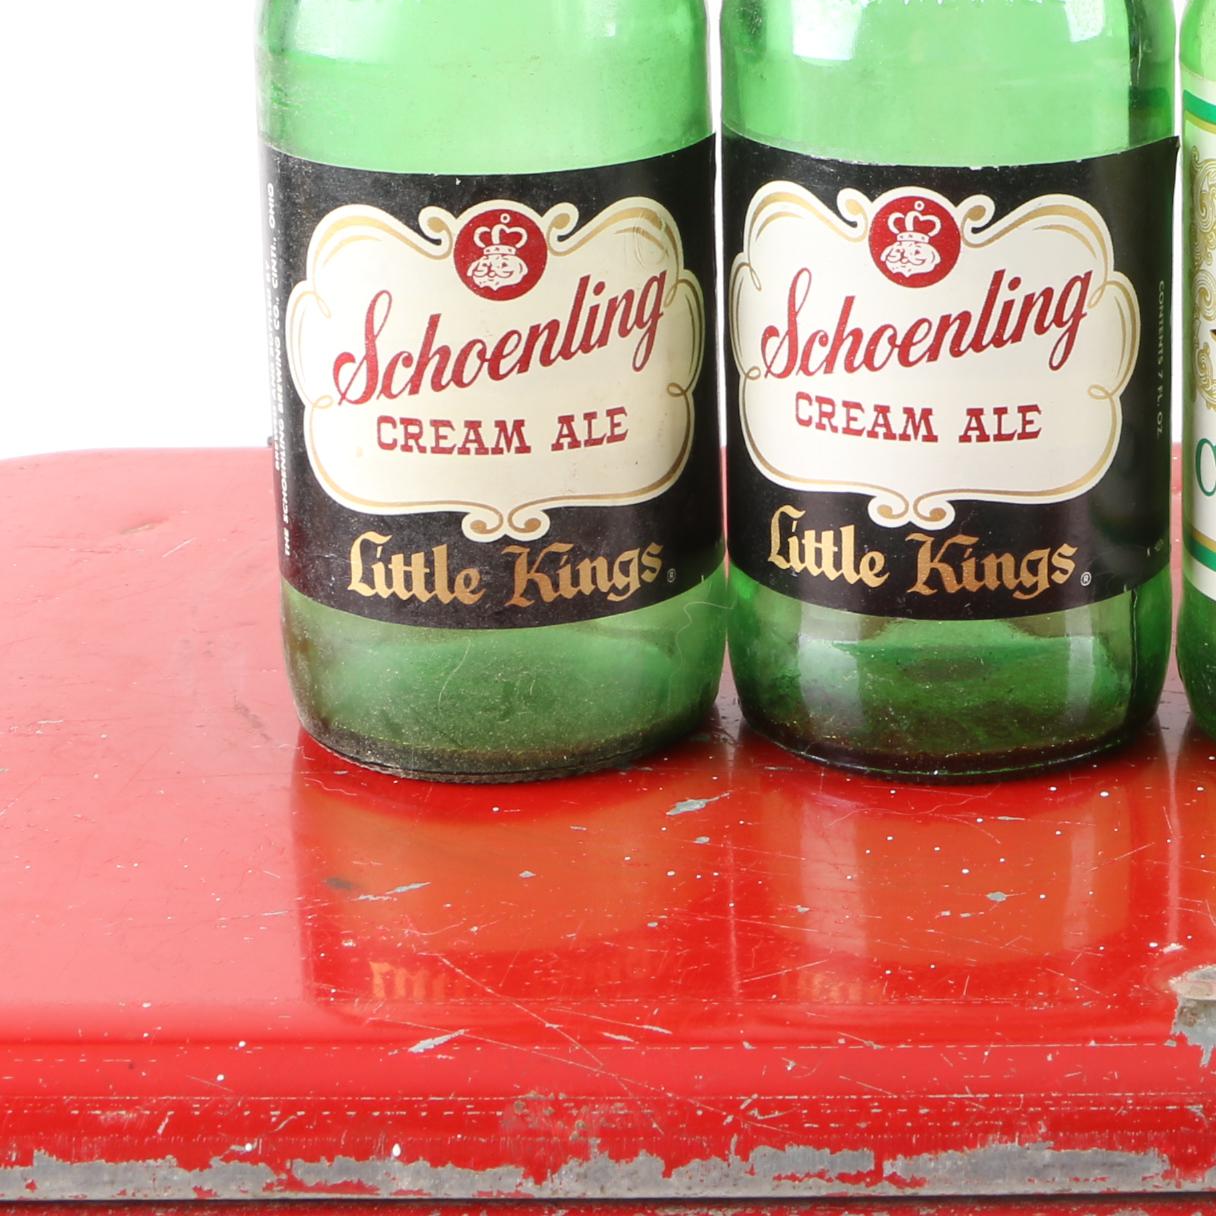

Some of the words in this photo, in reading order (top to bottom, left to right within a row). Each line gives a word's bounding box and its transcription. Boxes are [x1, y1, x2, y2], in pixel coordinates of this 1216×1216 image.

[267, 183, 276, 229] OHIO
[332, 270, 669, 405] Schoenling
[761, 267, 1093, 380] Schoenling
[273, 336, 285, 413] BREWING
[376, 415, 531, 455] CREAM
[551, 407, 629, 451] ALE
[795, 391, 938, 442] CREAM
[958, 404, 1042, 442] ALE
[278, 419, 289, 524] SCHOENLING
[283, 528, 291, 556] THE
[347, 530, 485, 605] Little
[500, 543, 664, 607] Kings
[767, 504, 890, 587] Little
[904, 532, 1078, 600] Kings
